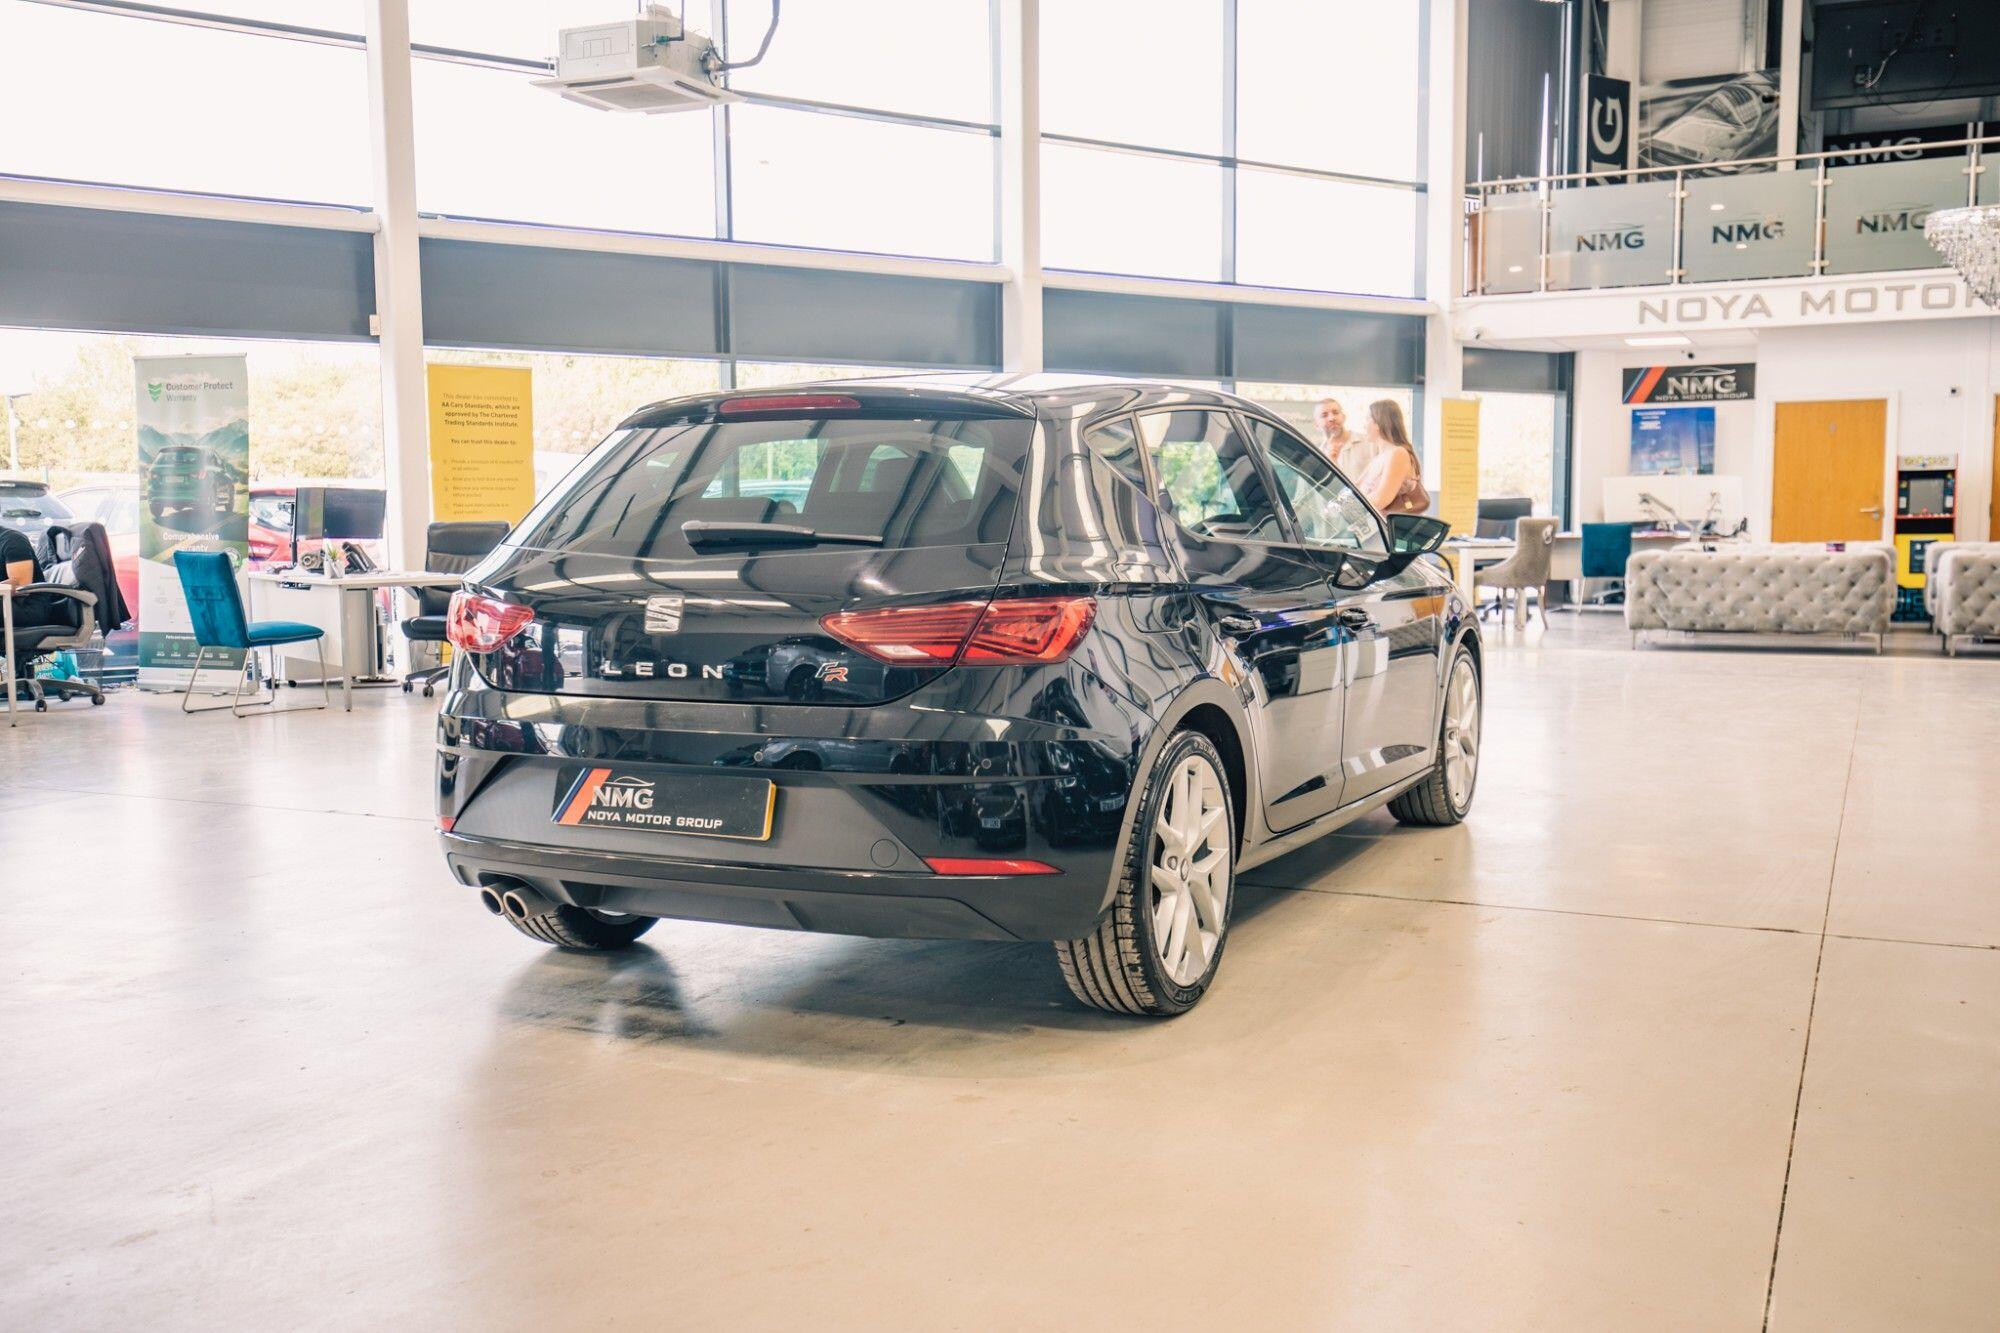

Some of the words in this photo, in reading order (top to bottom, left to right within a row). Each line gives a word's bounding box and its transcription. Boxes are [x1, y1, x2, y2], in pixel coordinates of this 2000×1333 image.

[1829, 136, 1923, 166] NMG
[1576, 231, 1645, 252] NMG
[1712, 221, 1784, 244] NMG
[1638, 293, 1773, 324] NOYA
[166, 383, 202, 391] Customer
[203, 381, 233, 390] Protect
[1667, 374, 1737, 395] NMG
[604, 660, 723, 679] LEON
[815, 661, 848, 682] FR
[590, 785, 654, 810] NMG
[587, 810, 621, 822] NOYA
[626, 812, 671, 826] MOTOR
[676, 816, 723, 830] GROUP
